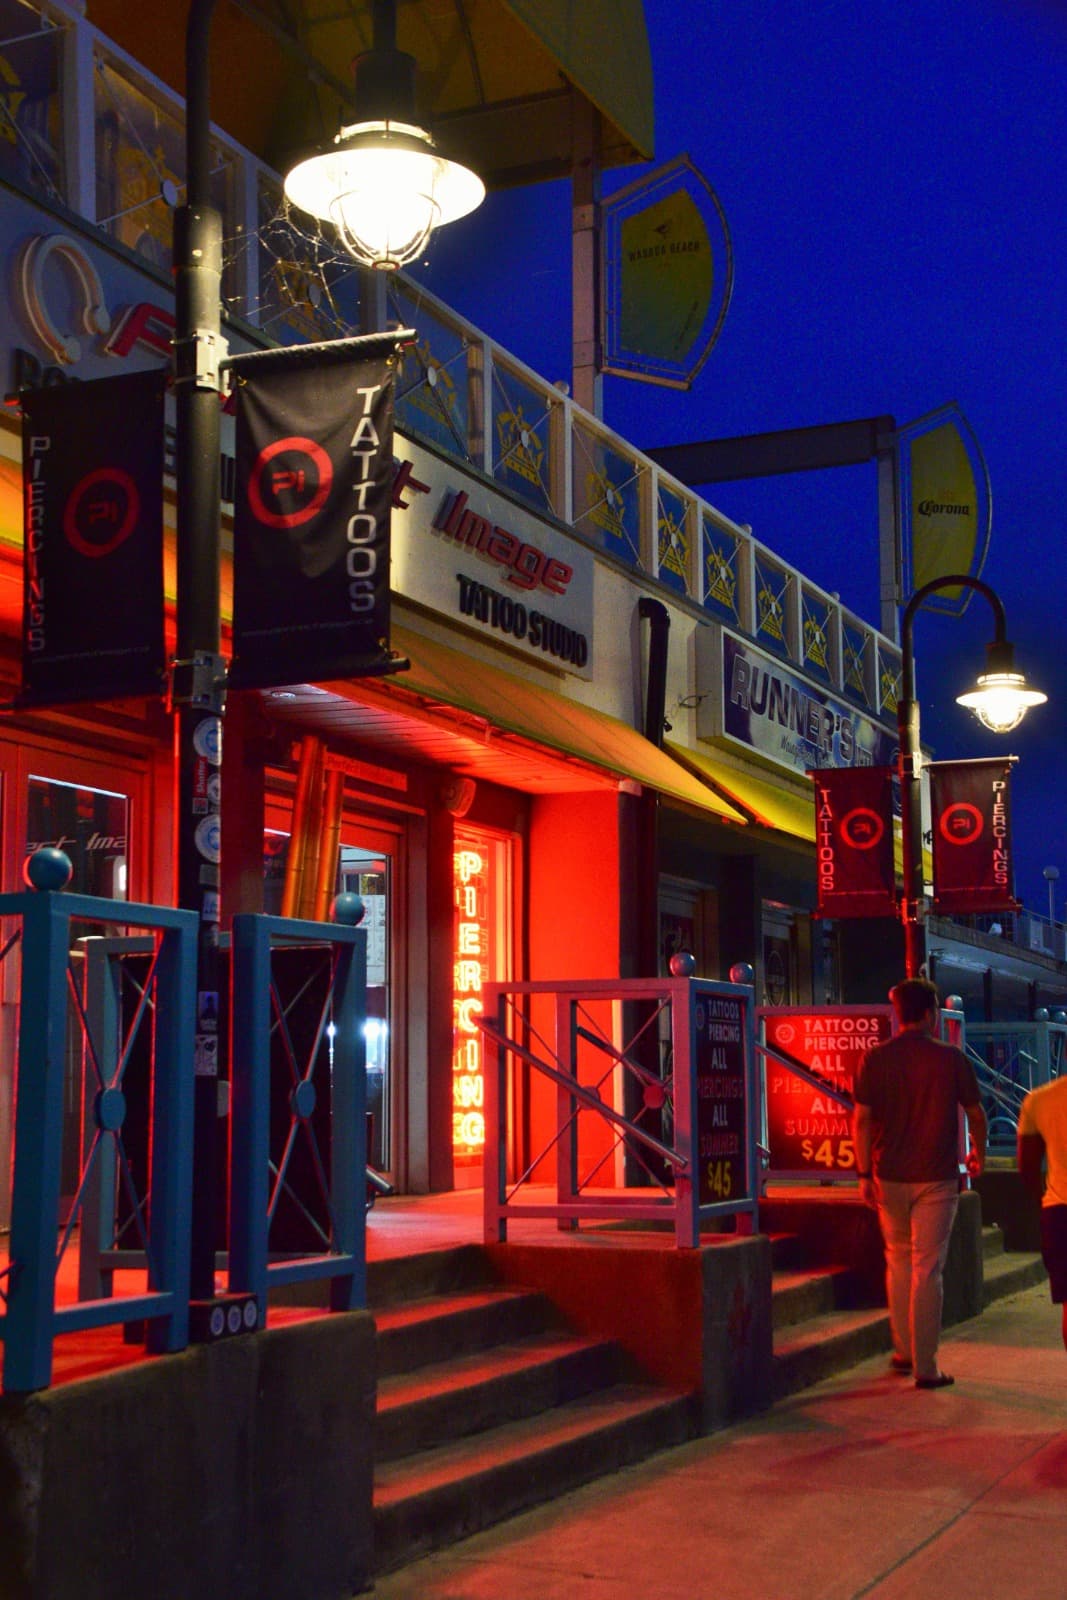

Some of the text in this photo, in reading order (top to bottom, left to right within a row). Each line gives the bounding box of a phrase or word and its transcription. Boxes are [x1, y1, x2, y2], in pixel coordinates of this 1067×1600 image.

[346, 385, 381, 613] TATTOOS
[918, 500, 970, 518] Corona
[28, 436, 51, 651] PIERCINGS
[442, 489, 573, 596] Image
[456, 572, 588, 668] TATTOO STUDIO
[731, 653, 856, 762] RUNNER'S
[819, 788, 835, 891] TATTOOS
[992, 780, 1009, 885] PIERCINGS
[458, 850, 485, 1147] PIERCING
[708, 999, 740, 1020] TATTOOS
[708, 1022, 740, 1043] PIERCING
[803, 1018, 880, 1033] TATTOOS
[711, 1047, 728, 1070] ALL
[804, 1035, 881, 1052] PIERCING
[809, 1054, 846, 1072] ALL
[712, 1103, 728, 1127] ALL
[801, 1139, 855, 1169] $45
[707, 1161, 732, 1198] $45
